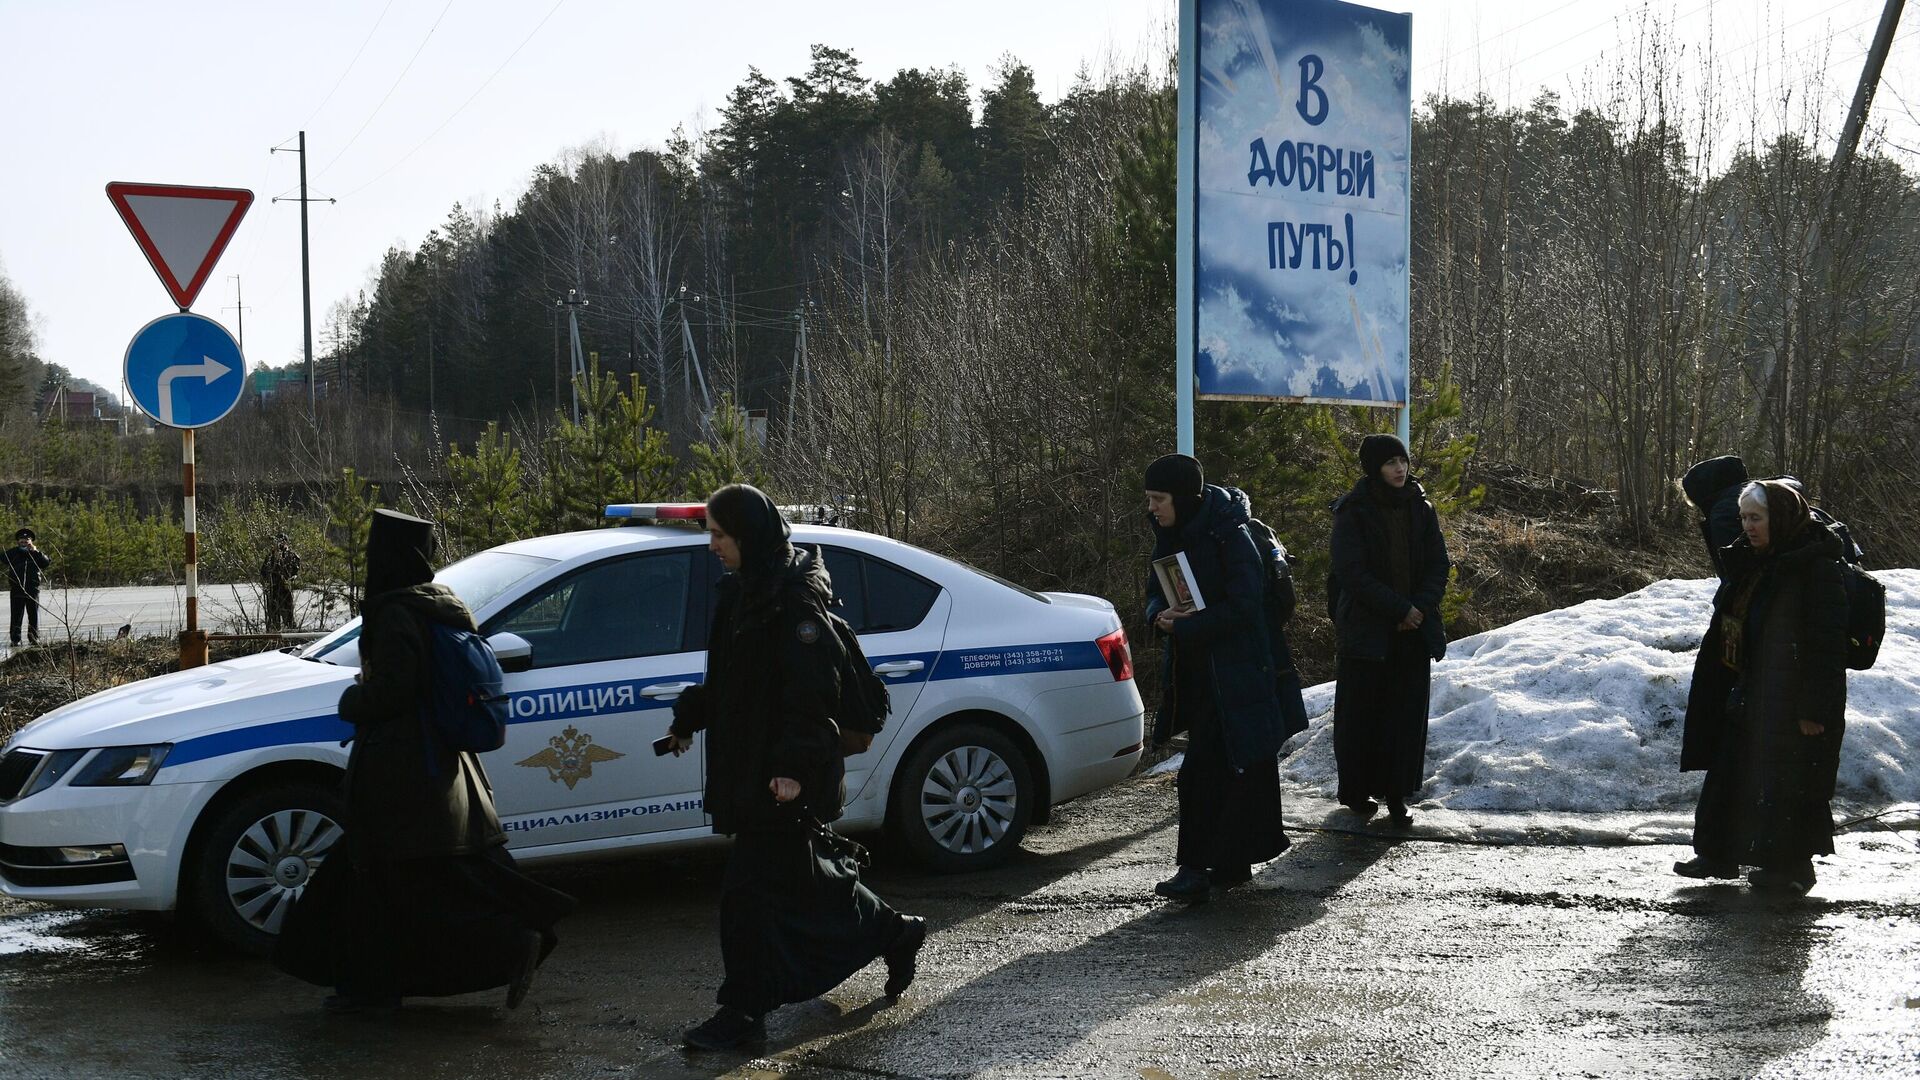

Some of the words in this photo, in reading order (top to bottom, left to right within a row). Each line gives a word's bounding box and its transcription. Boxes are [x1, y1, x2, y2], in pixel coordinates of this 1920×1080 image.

[1296, 54, 1329, 126] В
[1248, 137, 1375, 199] ДОБРЫЙ
[1267, 212, 1358, 286] ПУТЬ!
[960, 653, 1001, 663] ТЕЛЕФОНЫ
[1003, 652, 1024, 660] (343)
[964, 660, 1001, 670] ДОВЕРИЯ
[1004, 659, 1024, 667] (343)
[502, 799, 702, 832] ЕЦИАЛИЗИРОВАНН
